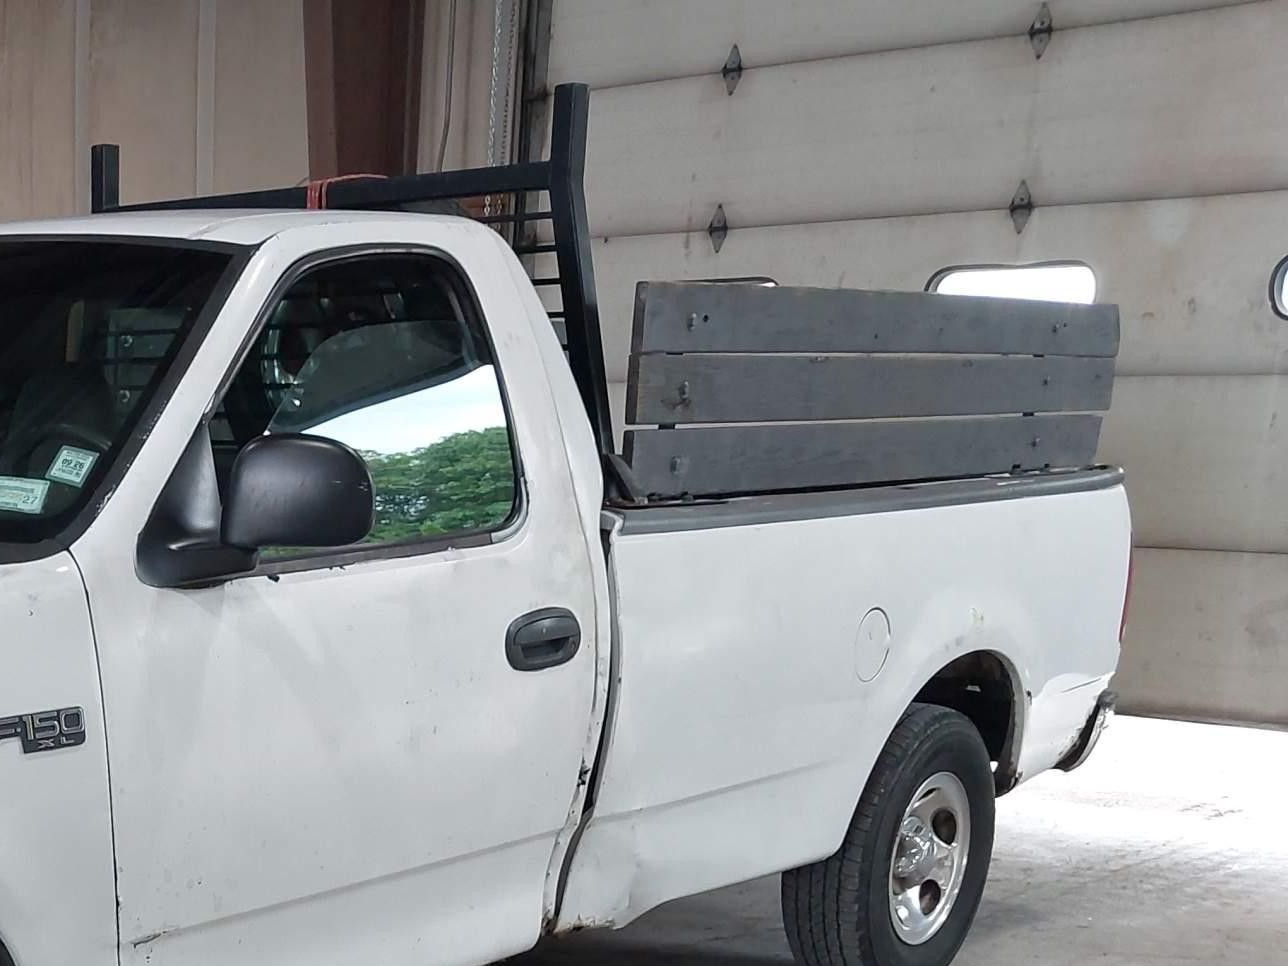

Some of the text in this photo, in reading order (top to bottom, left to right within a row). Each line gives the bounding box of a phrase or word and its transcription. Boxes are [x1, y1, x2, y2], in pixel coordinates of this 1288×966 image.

[61, 458, 72, 466] 09
[22, 496, 39, 505] 27
[37, 736, 75, 749] XL
